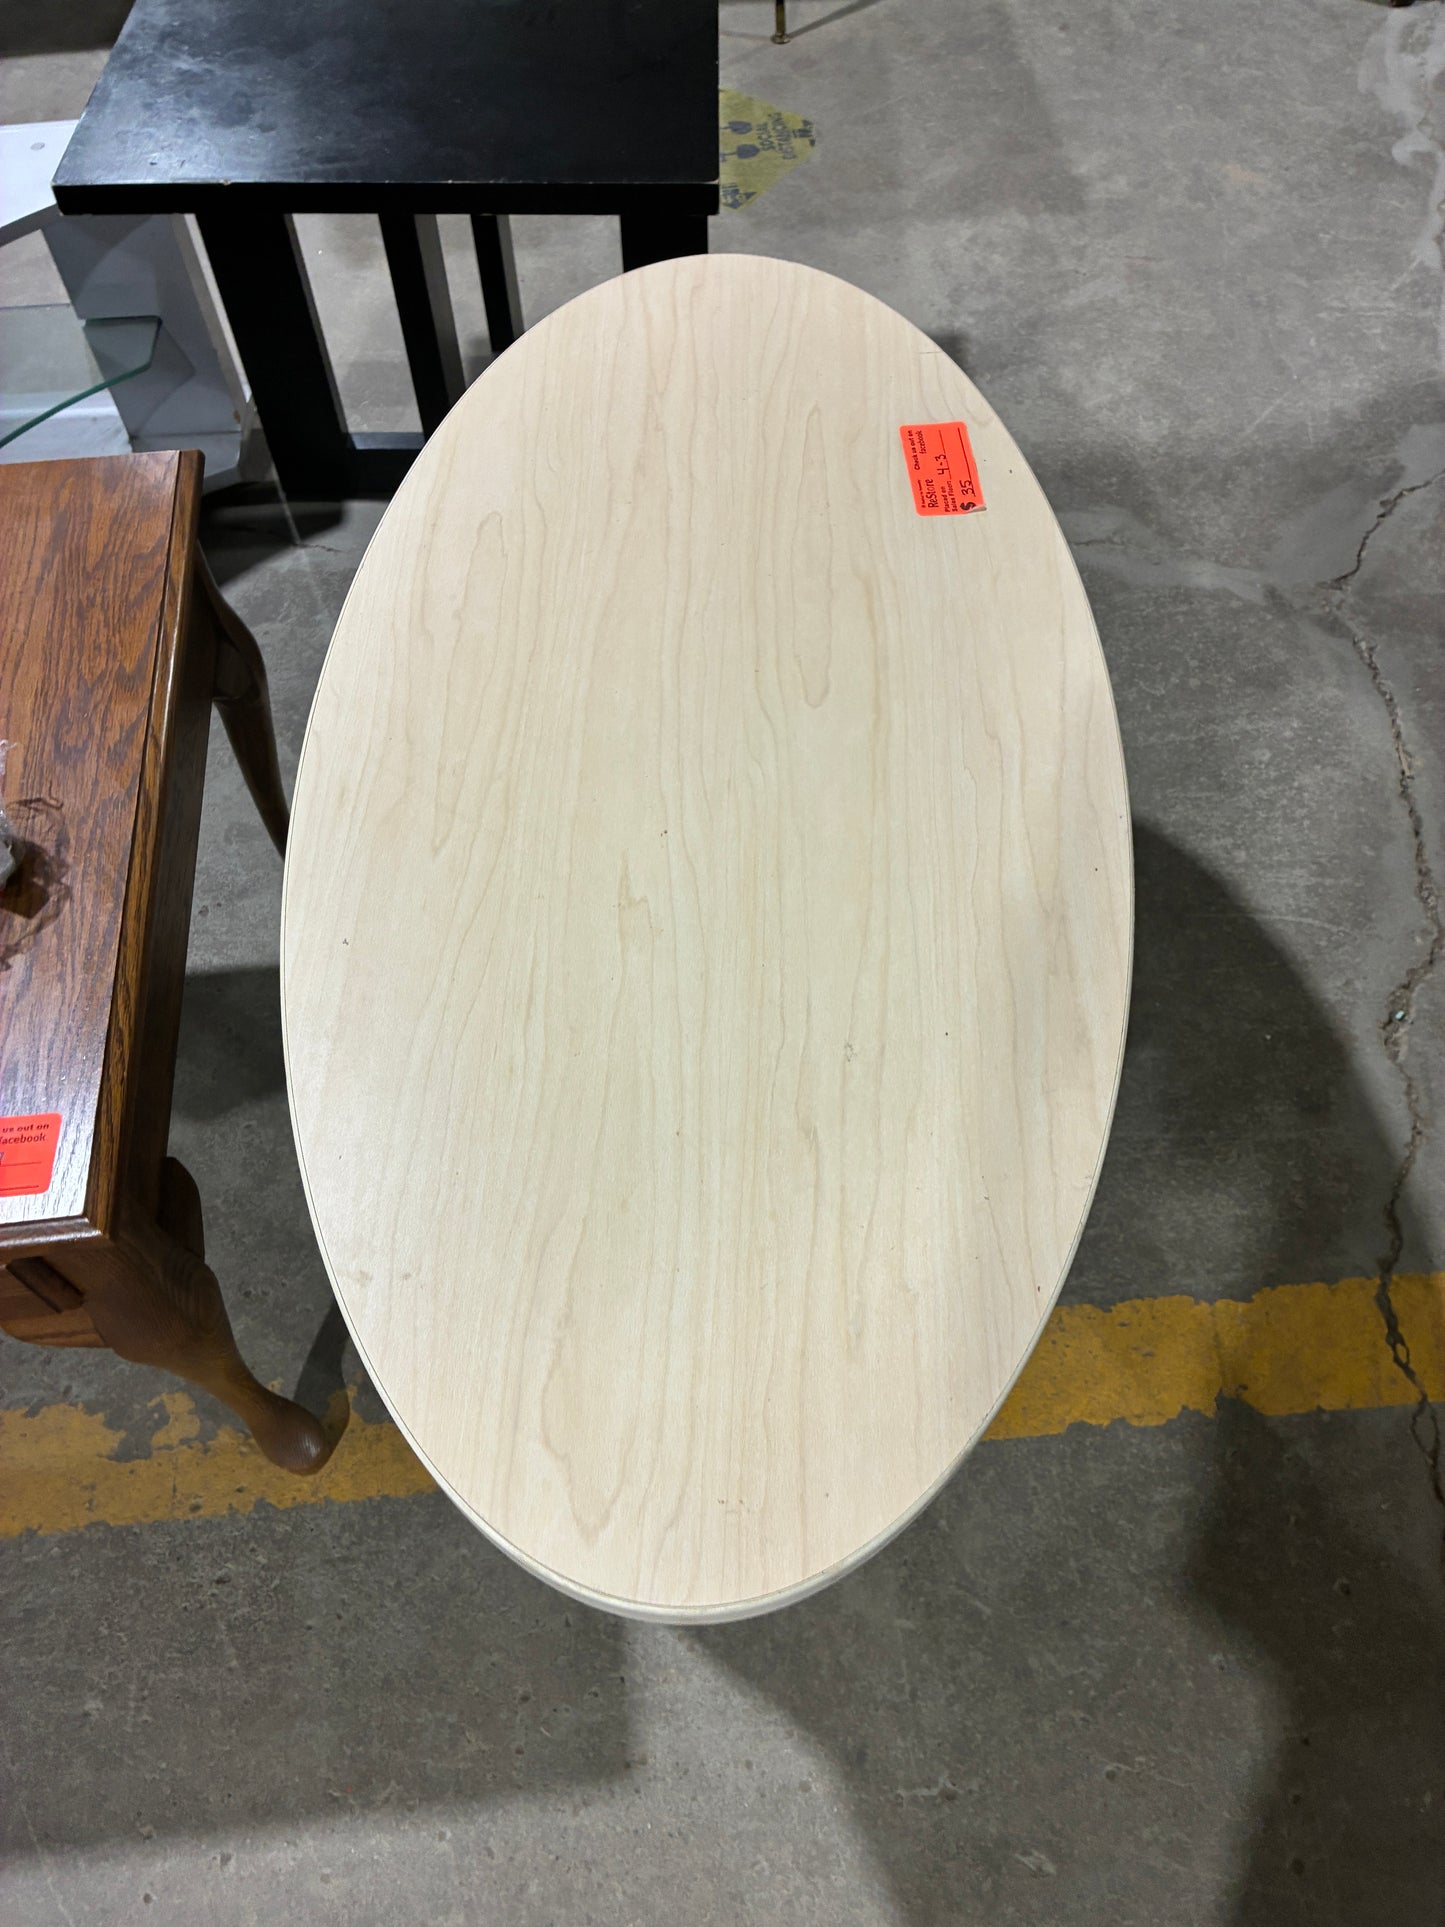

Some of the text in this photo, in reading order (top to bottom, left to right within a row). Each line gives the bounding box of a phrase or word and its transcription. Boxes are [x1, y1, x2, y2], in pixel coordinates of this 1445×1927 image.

[756, 123, 776, 151] SOCIAL
[915, 430, 927, 454] facebook
[912, 454, 920, 470] Check
[925, 479, 939, 508] ReStore
[942, 495, 950, 512] Placed
[959, 480, 976, 511] $ 35
[17, 1123, 34, 1131] out
